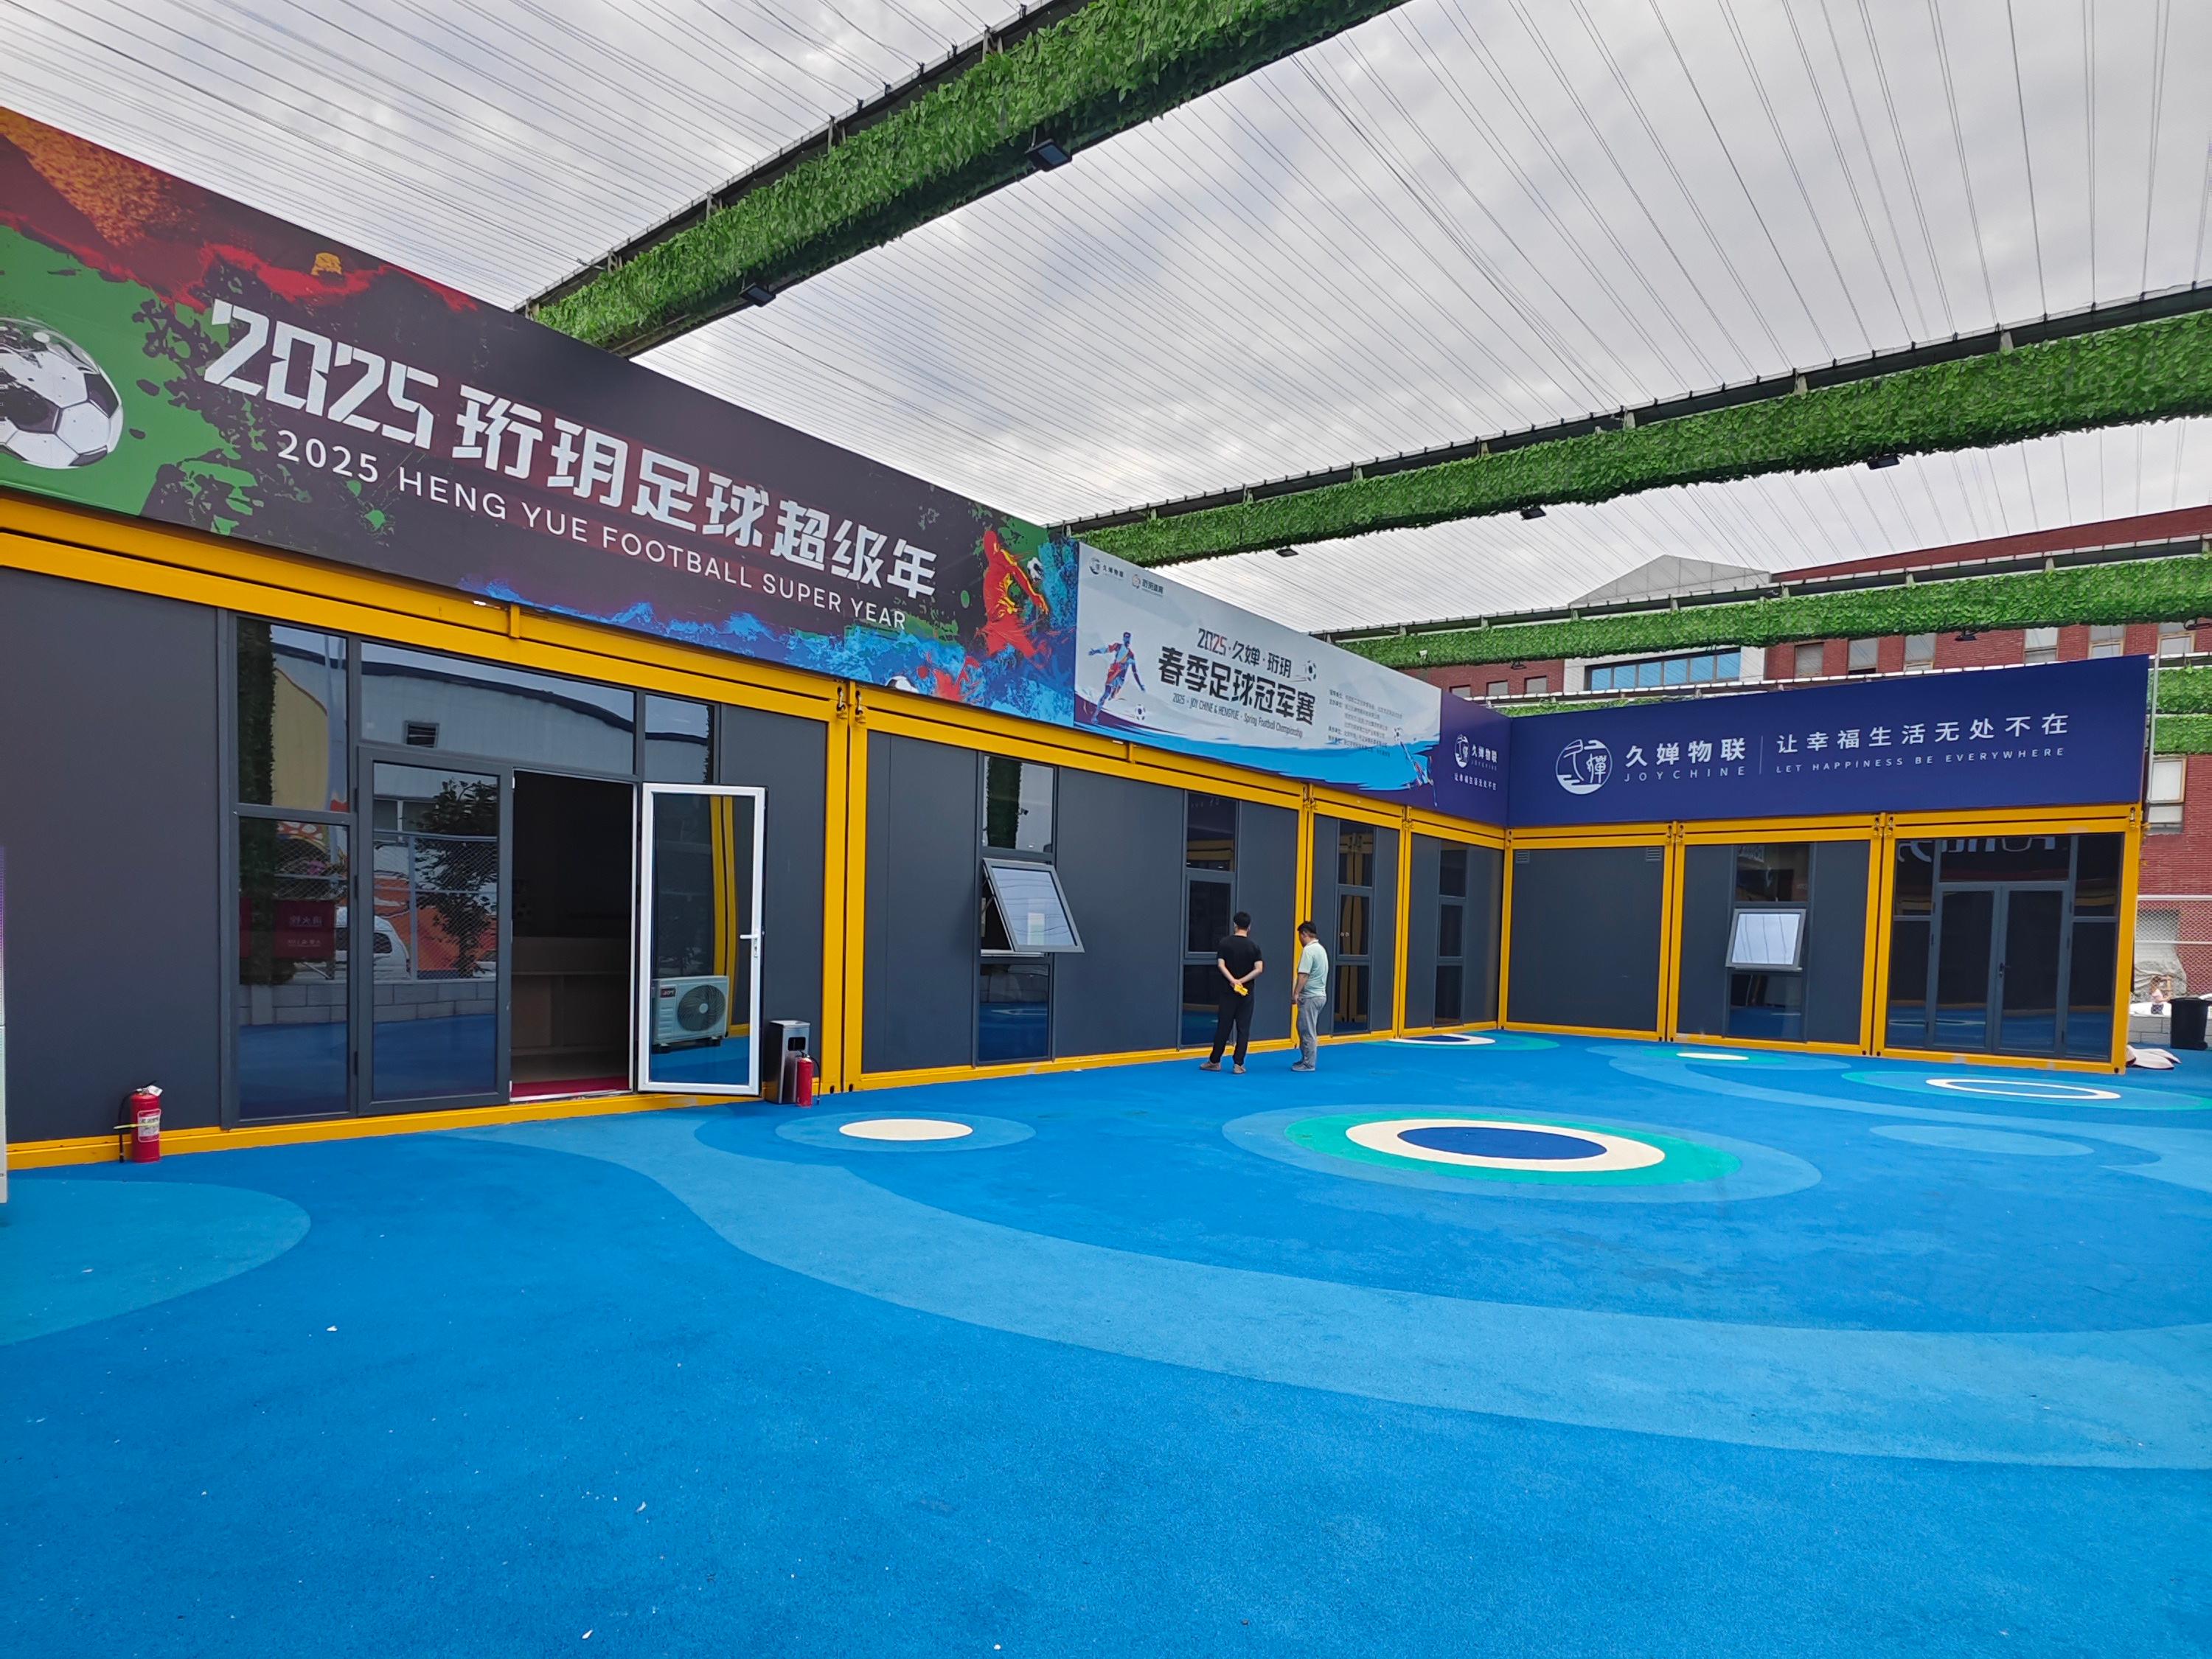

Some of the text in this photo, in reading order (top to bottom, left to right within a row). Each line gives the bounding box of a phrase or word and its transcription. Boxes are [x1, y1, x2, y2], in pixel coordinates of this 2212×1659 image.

[204, 299, 937, 599] 2025 珩玥足球超级年
[277, 430, 905, 630] 2025 HENG YUE FOOTBALL SUPER YEAR
[1158, 646, 1316, 726] 春季足球冠军赛
[1624, 737, 1746, 768] 久婵物联
[1775, 713, 2069, 754] 让幸福生活无处不在
[1624, 765, 1745, 782] JOYCHINE
[1776, 747, 2065, 773] LET HAPPINESS BE EVERYWHERE
